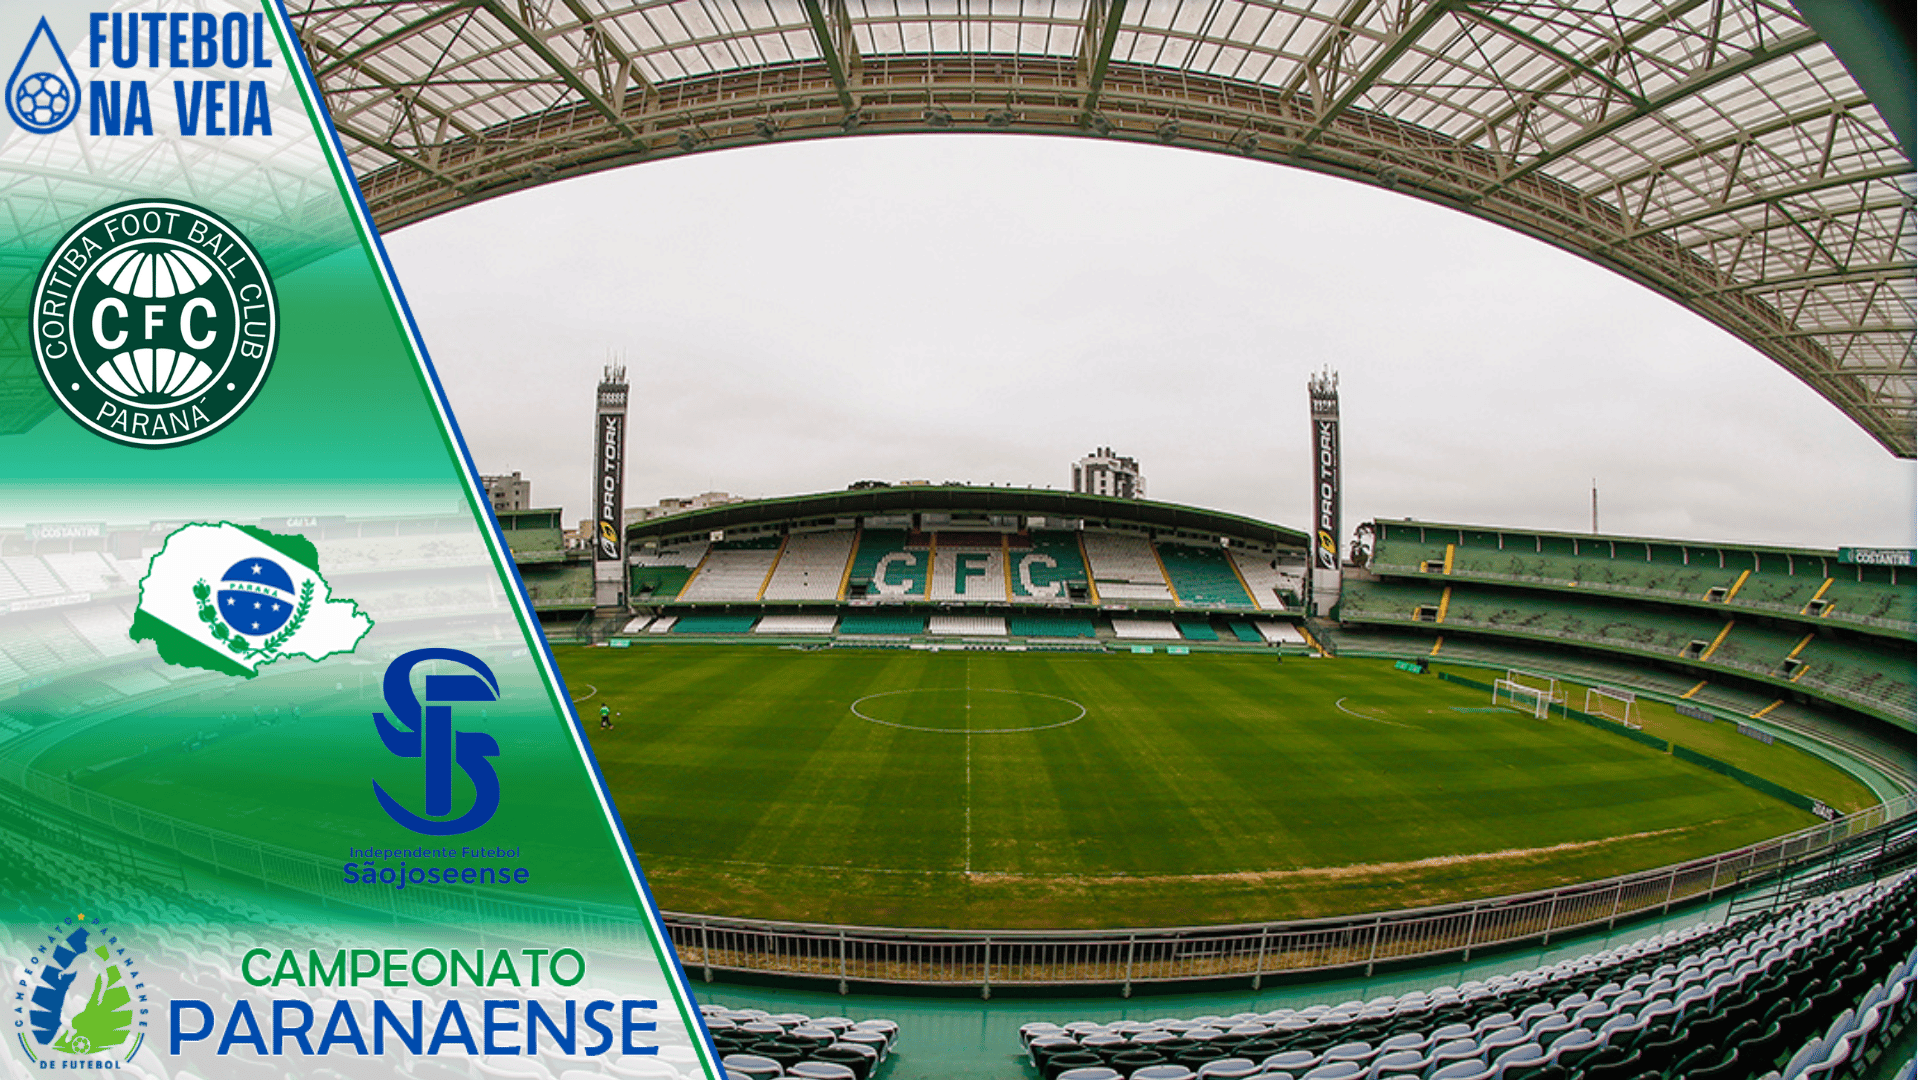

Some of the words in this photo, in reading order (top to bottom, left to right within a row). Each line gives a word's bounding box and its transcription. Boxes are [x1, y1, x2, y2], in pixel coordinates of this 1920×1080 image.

[605, 416, 616, 472] TORK
[1321, 421, 1332, 478] TORK
[604, 476, 614, 520] PRO
[1321, 483, 1332, 530] PRO
